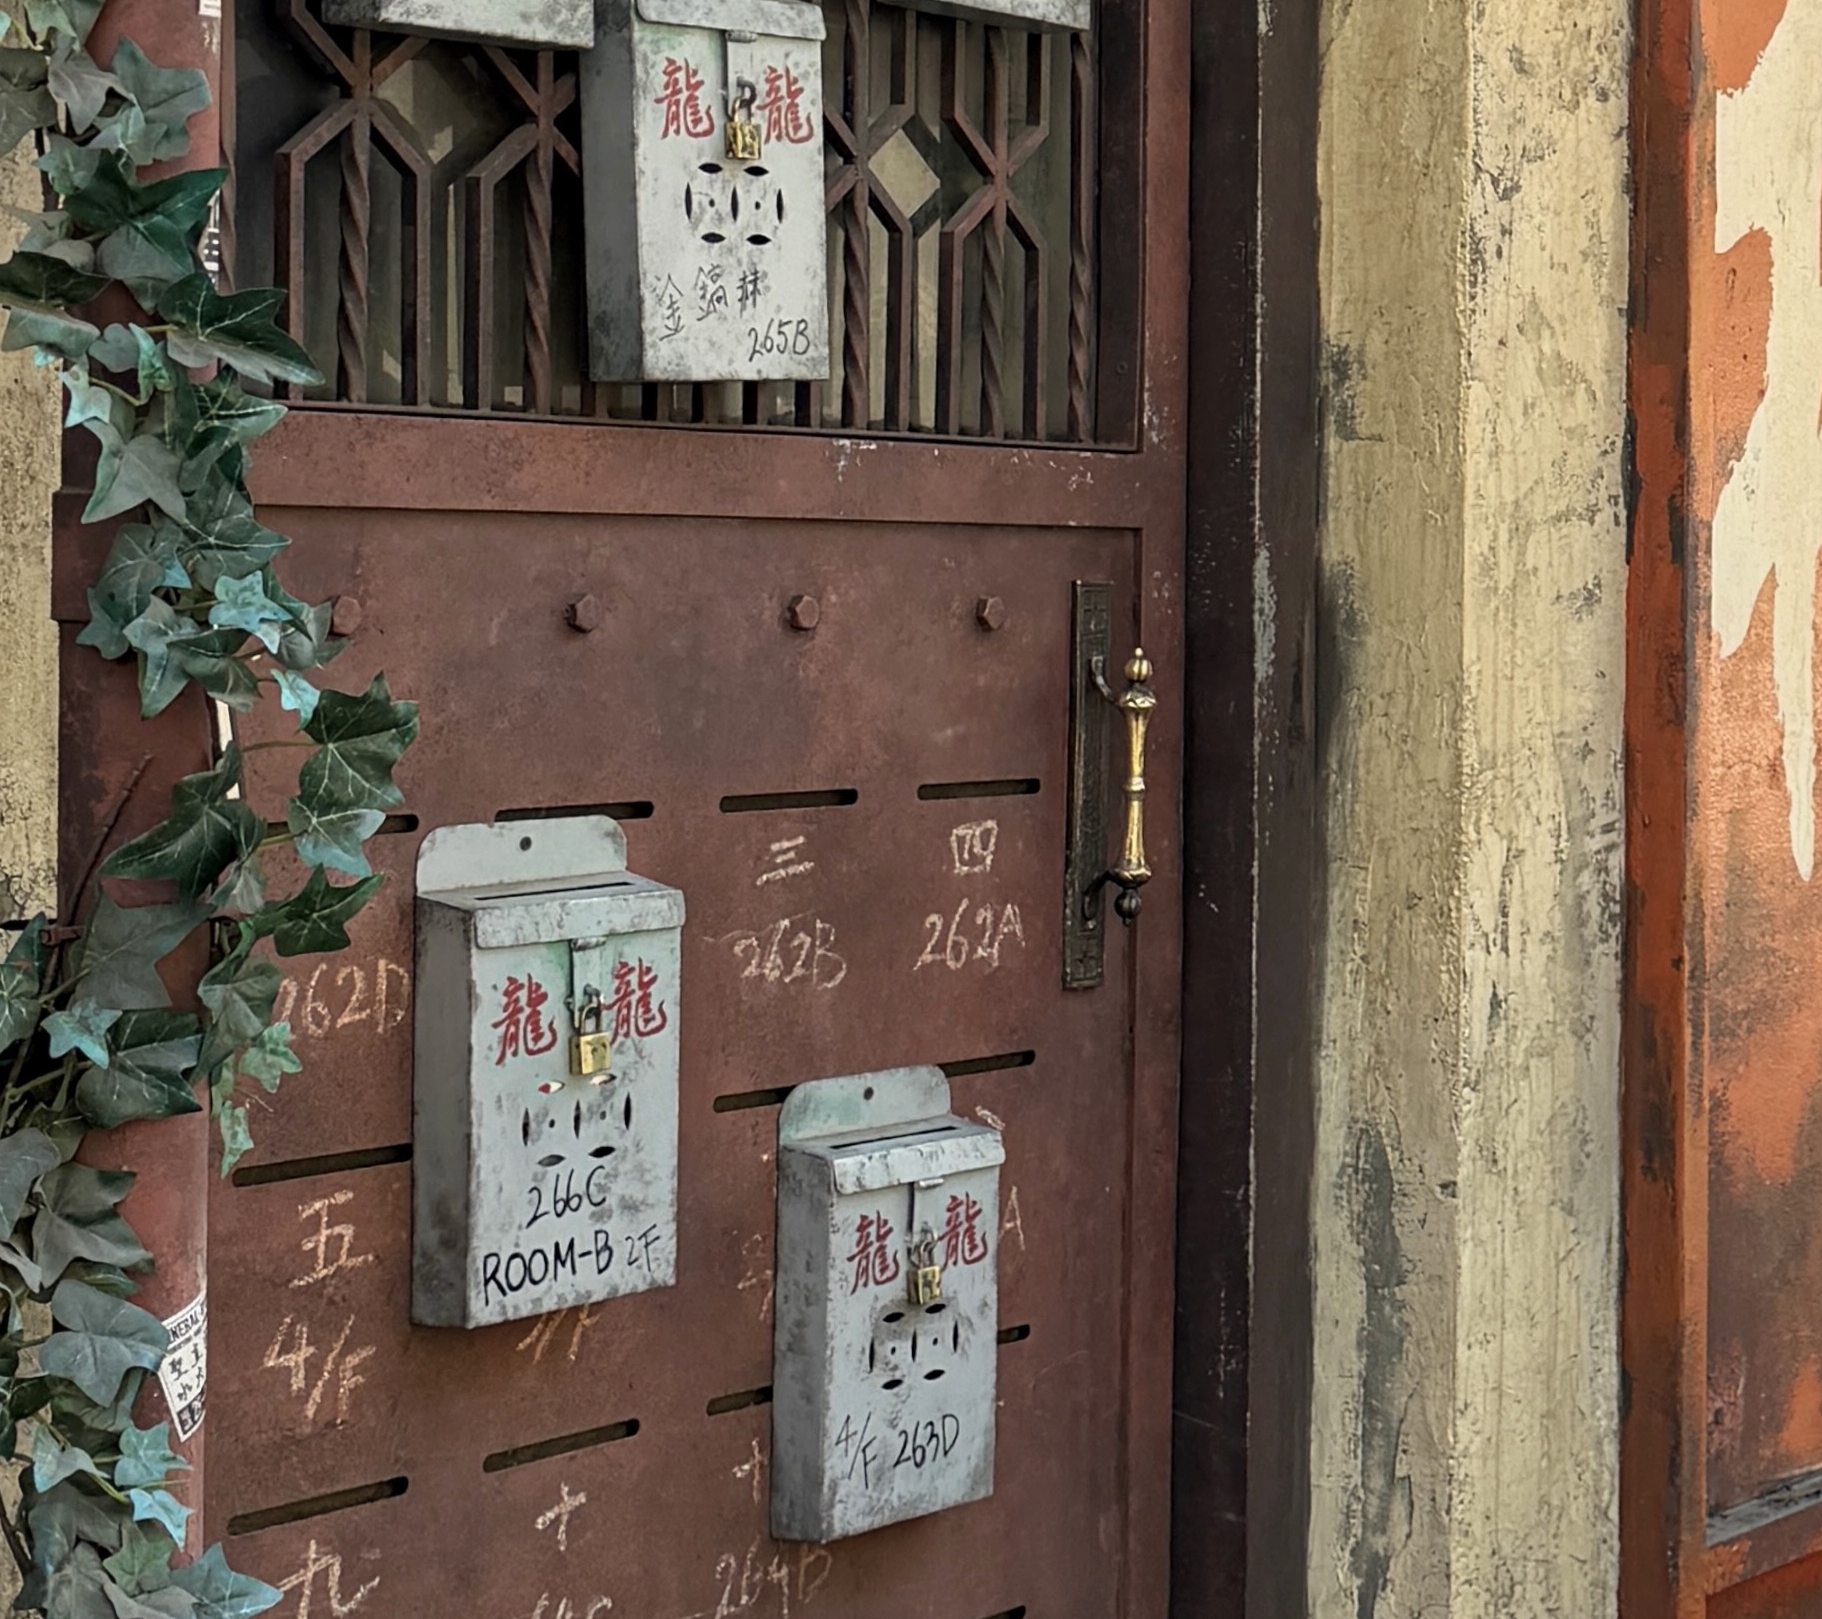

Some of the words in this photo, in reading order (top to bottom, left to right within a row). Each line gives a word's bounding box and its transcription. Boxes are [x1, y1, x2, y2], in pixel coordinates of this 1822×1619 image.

[654, 57, 715, 140] 龍
[757, 65, 814, 144] 龍
[749, 318, 811, 364] 265B
[756, 835, 816, 886] 三
[491, 973, 557, 1066] 龍
[601, 957, 667, 1045] 龍
[290, 1190, 382, 1288] 五
[525, 1164, 608, 1230] 266C
[482, 1229, 614, 1307] ROOM-B
[625, 1223, 661, 1273] 2F
[847, 1210, 900, 1295] 龍
[938, 1192, 987, 1272] 龍
[835, 1411, 878, 1489] 4/F
[893, 1412, 960, 1470] 263D
